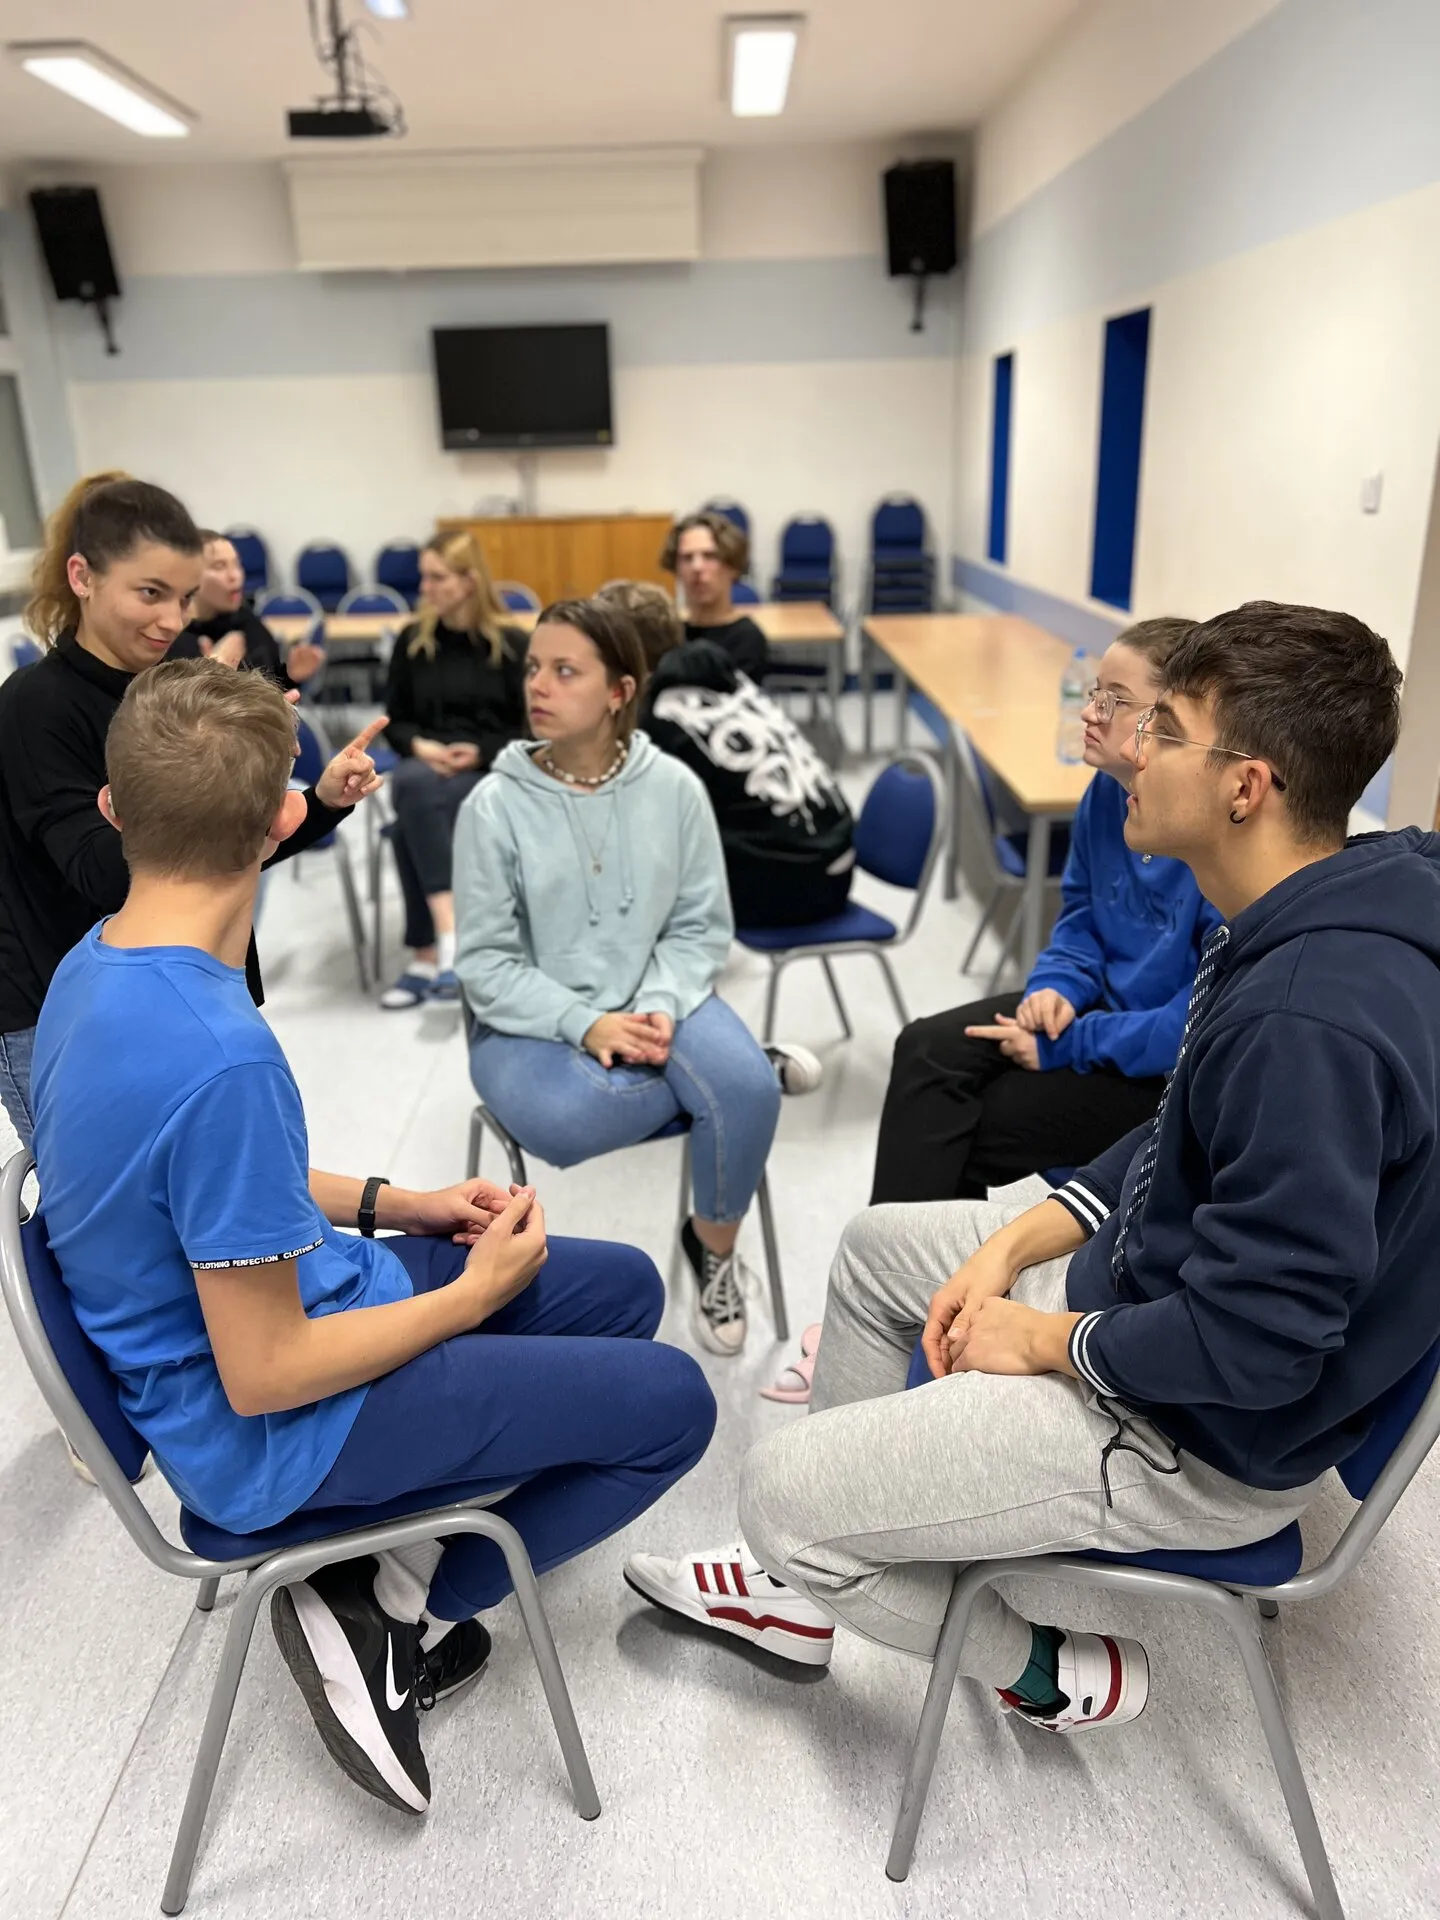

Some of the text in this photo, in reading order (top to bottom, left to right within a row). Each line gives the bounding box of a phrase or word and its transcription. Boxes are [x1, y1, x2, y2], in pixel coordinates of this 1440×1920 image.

[200, 1261, 230, 1269] CLOTHING
[232, 1254, 278, 1267] PERFECTION
[283, 1244, 315, 1259] CLOTHIN
